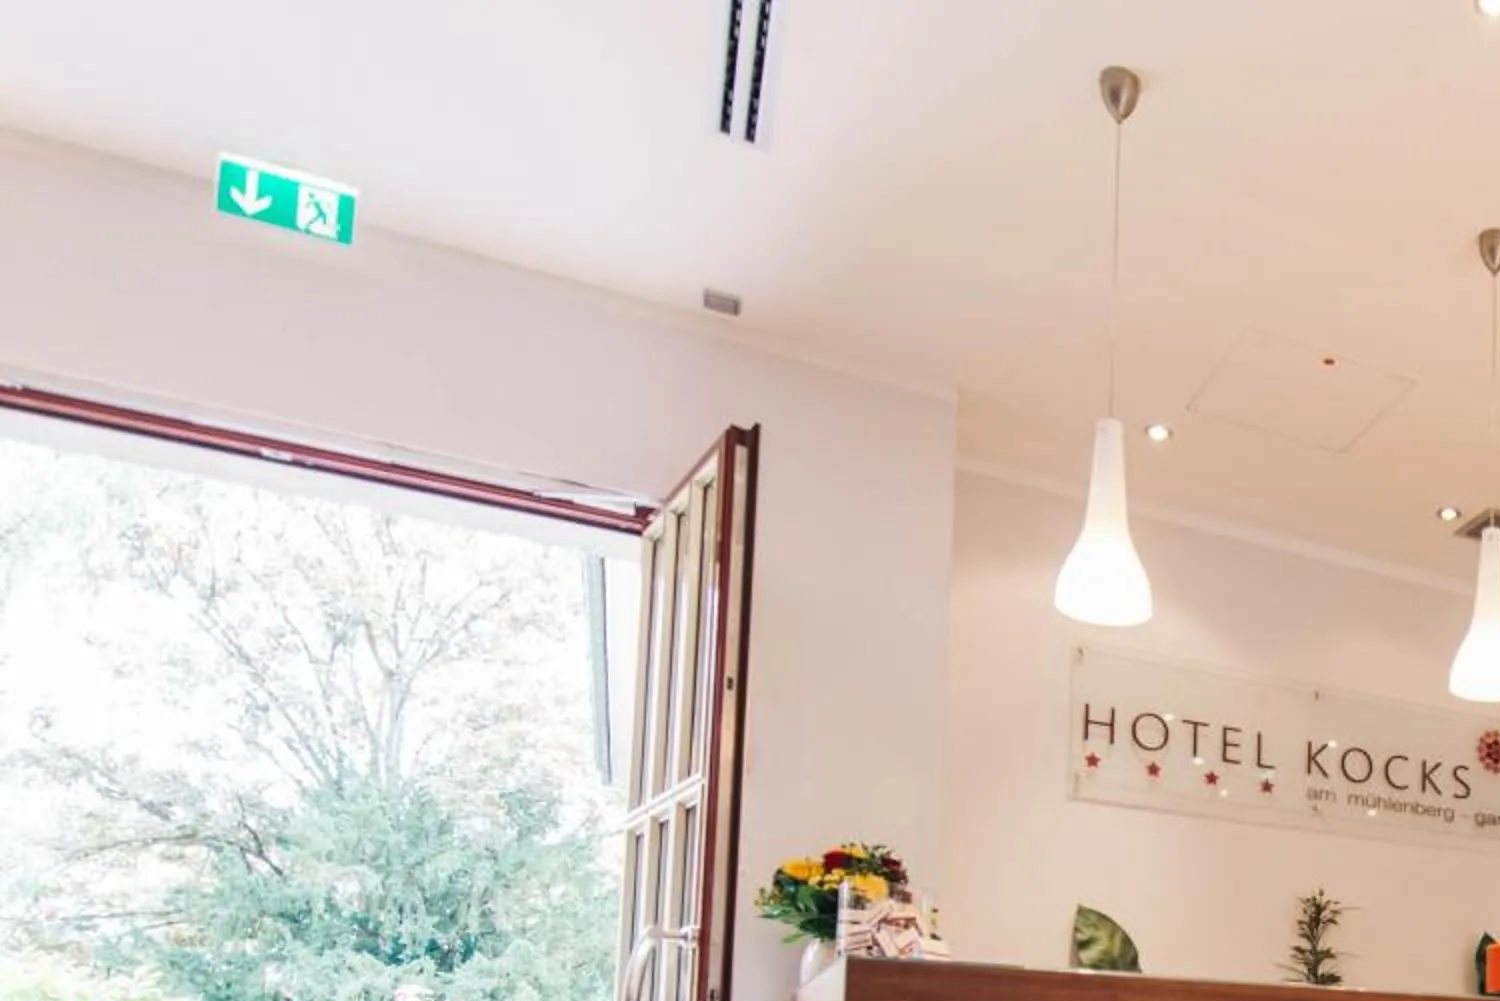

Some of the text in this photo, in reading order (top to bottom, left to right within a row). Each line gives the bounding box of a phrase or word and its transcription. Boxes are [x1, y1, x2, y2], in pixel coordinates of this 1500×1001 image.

[1082, 703, 1471, 800] HOTEL KOCKS
[1305, 786, 1337, 801] am
[1346, 791, 1455, 823] mühlenberg
